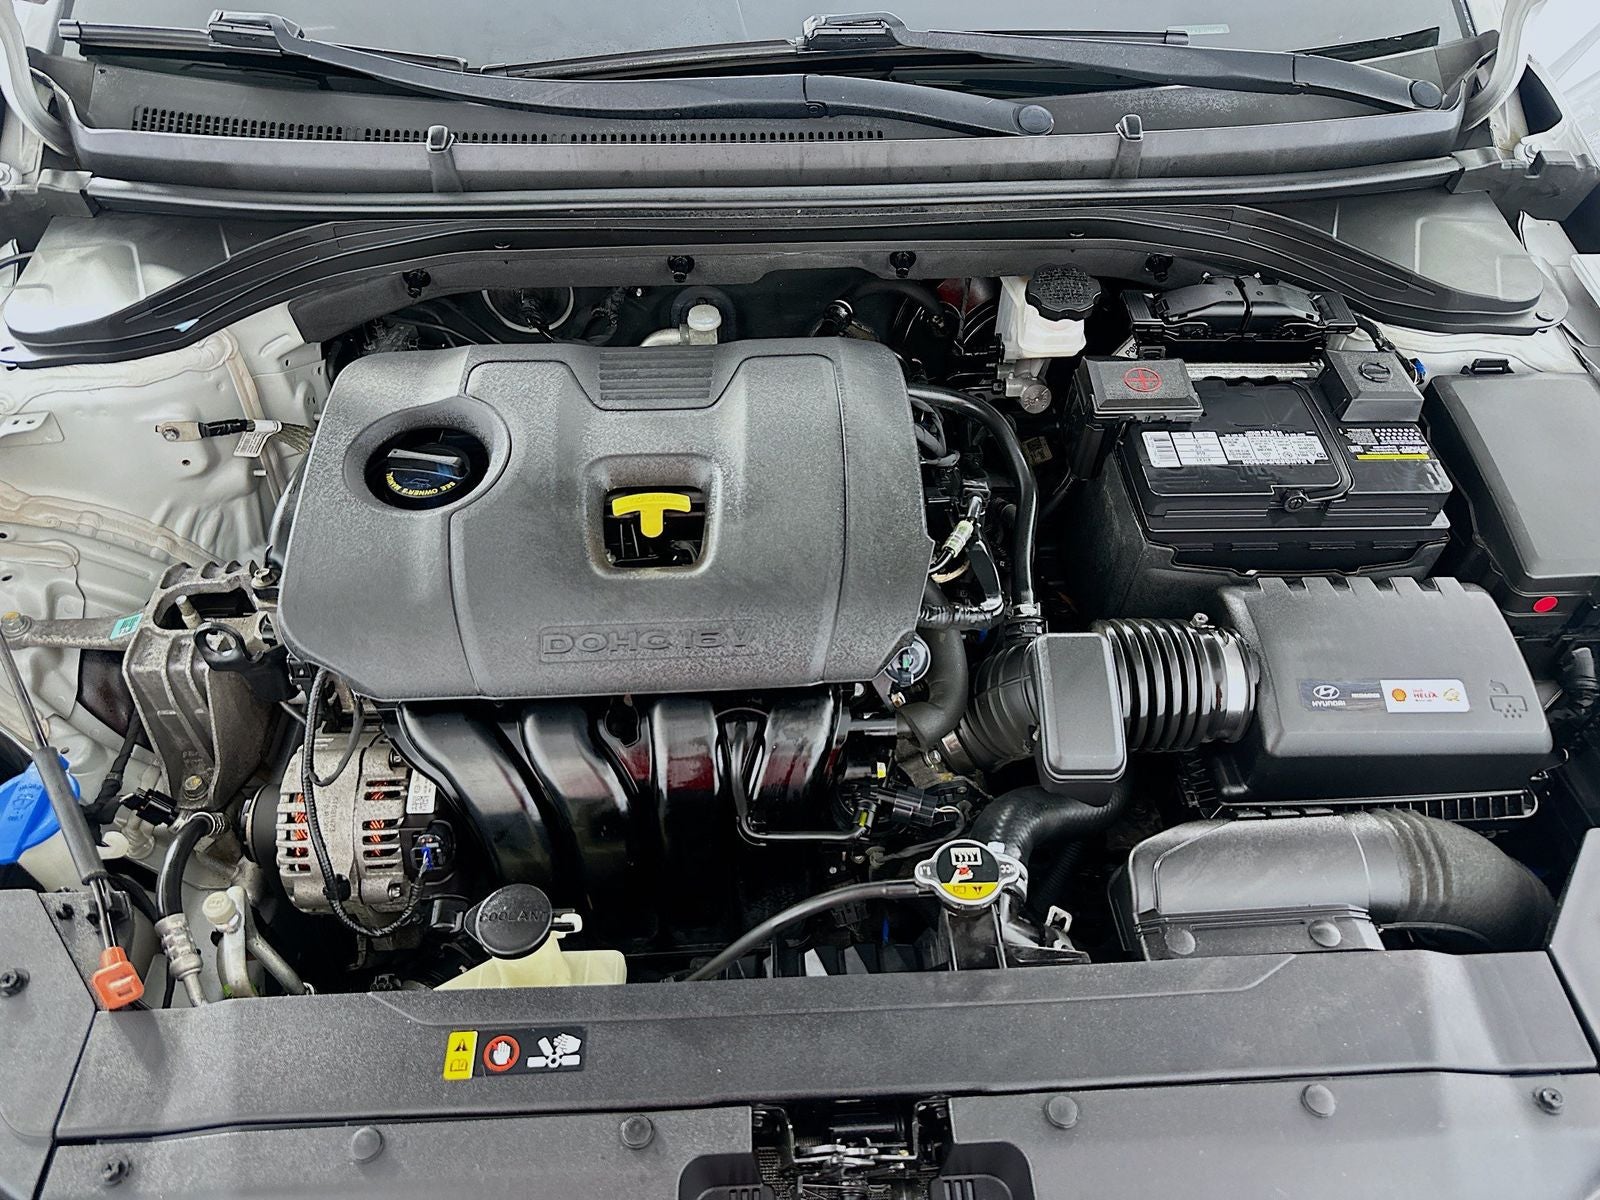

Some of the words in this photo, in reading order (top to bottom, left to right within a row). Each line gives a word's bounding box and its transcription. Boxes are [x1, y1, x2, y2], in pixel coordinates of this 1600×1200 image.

[402, 488, 438, 496] OWNER'S
[541, 630, 672, 655] DOHC
[480, 911, 548, 922] COOLANT
